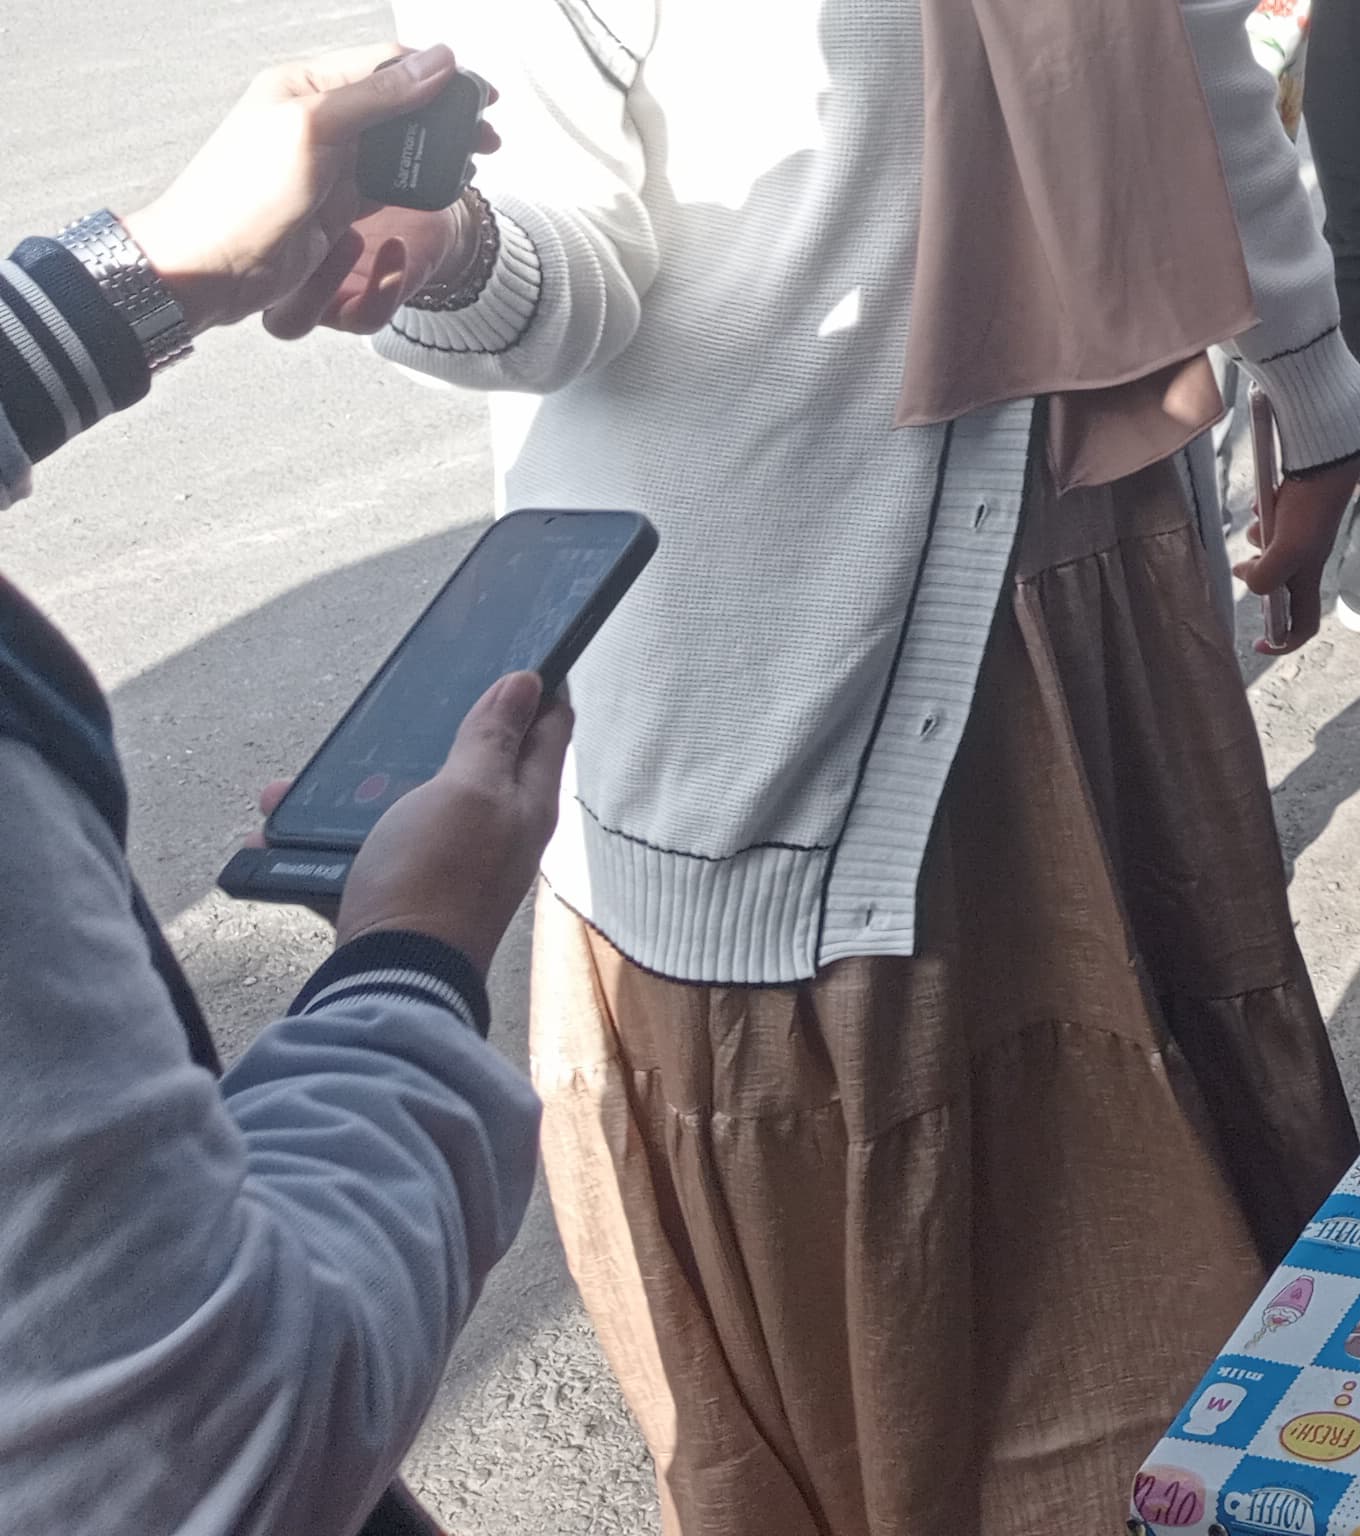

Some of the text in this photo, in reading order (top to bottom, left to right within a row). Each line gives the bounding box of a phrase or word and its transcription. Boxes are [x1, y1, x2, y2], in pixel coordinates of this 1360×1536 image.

[1217, 1366, 1265, 1381] milk
[1289, 1423, 1356, 1448] FRESH!
[1250, 1491, 1307, 1529] COFFEE
